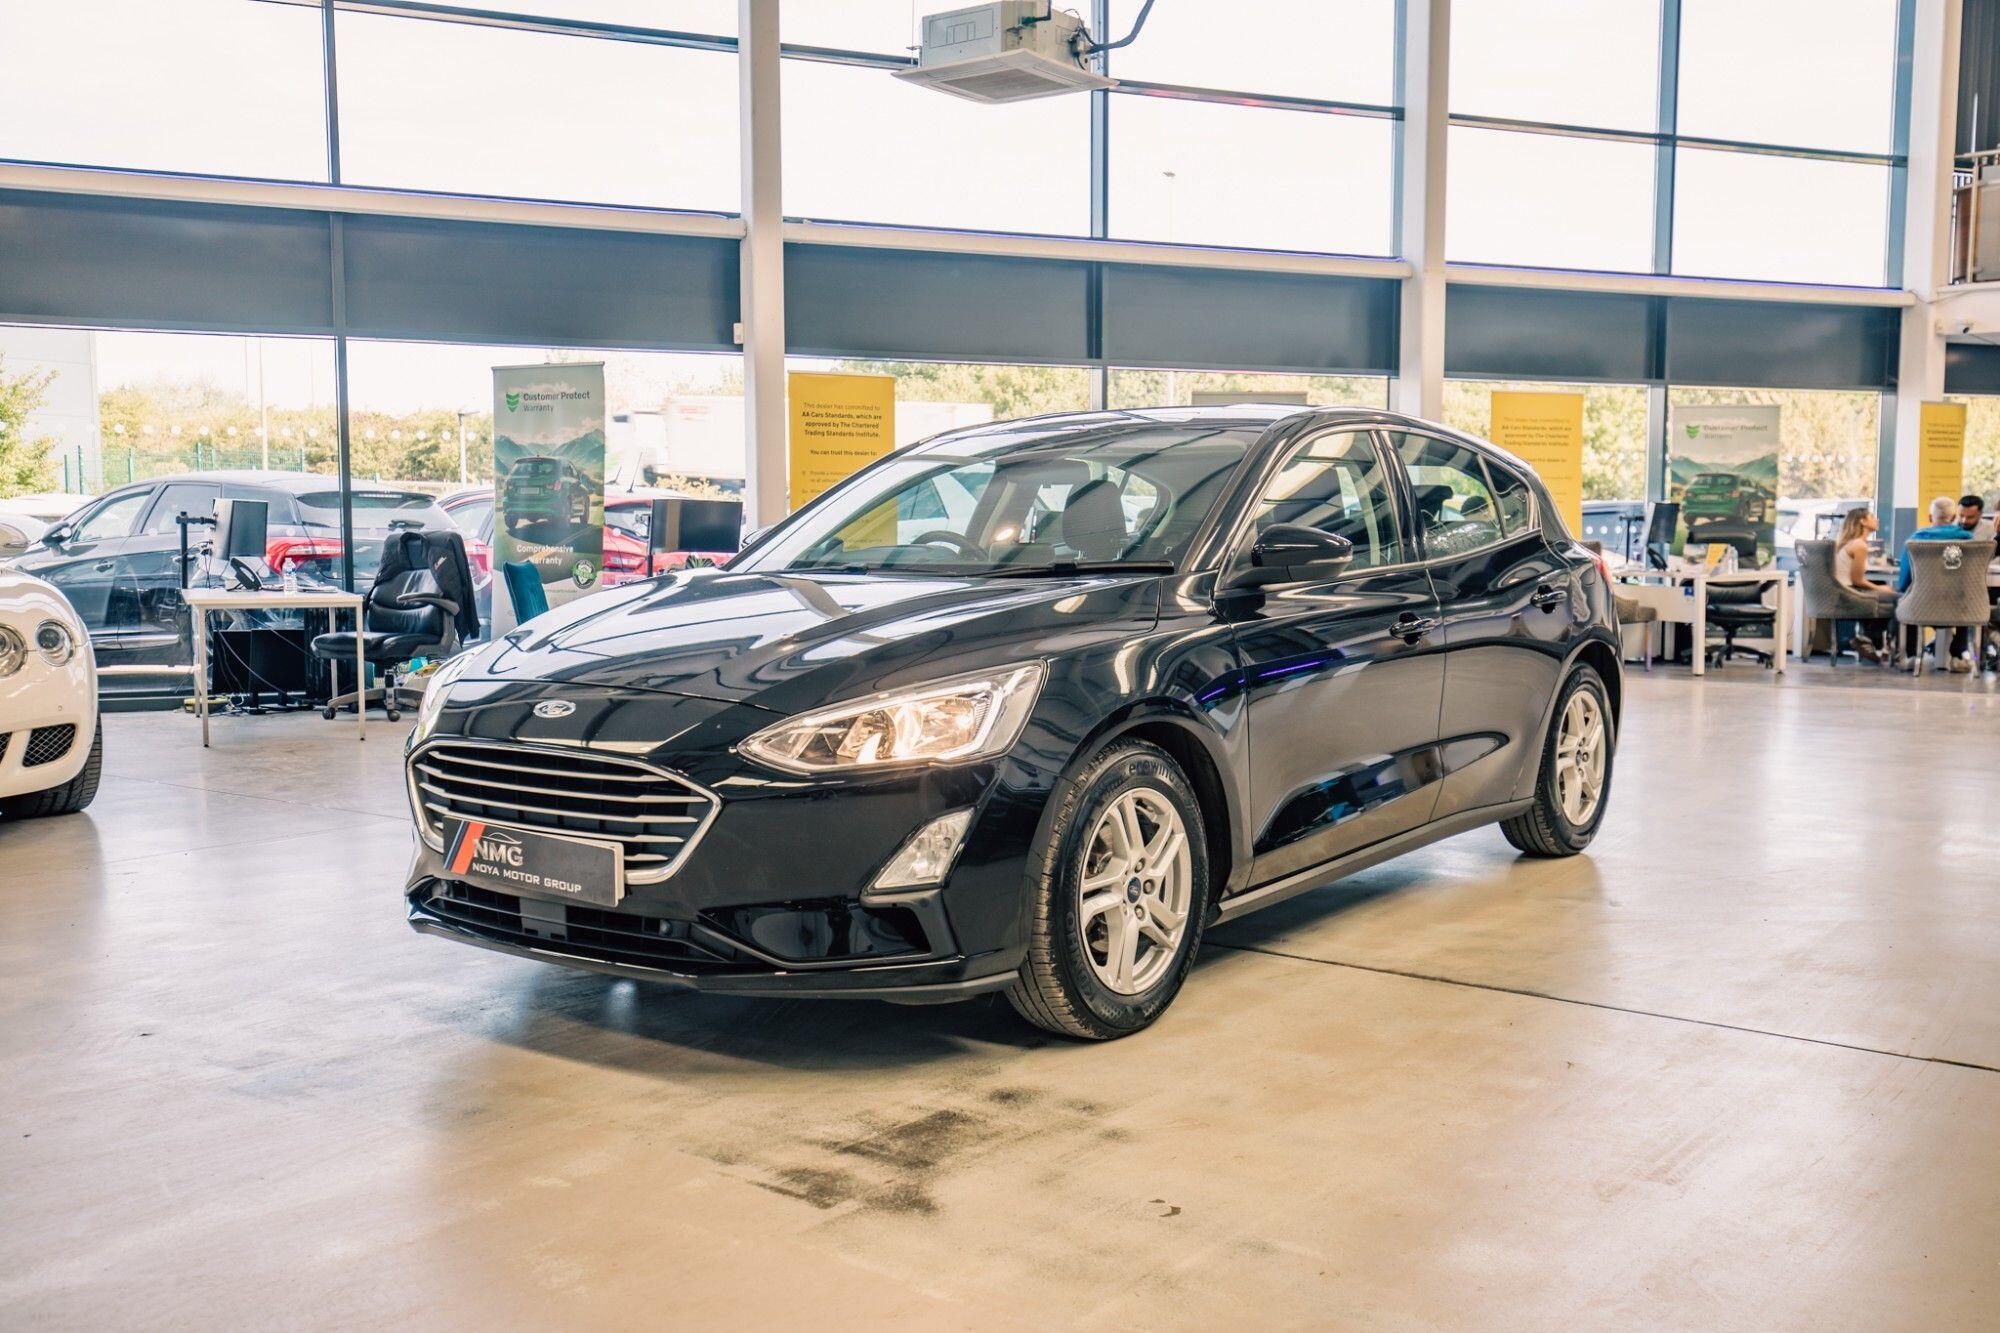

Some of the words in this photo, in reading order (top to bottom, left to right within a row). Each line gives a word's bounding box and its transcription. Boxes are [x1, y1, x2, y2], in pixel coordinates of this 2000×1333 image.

[523, 392, 559, 401] Customer
[560, 391, 590, 400] Protect
[523, 404, 554, 412] Warranty
[804, 429, 825, 437] Trading
[517, 544, 574, 553] Comprehensive
[473, 839, 523, 866] NMG
[472, 863, 499, 876] NOYA
[503, 869, 540, 885] MOTOR
[543, 877, 582, 893] GROUP
